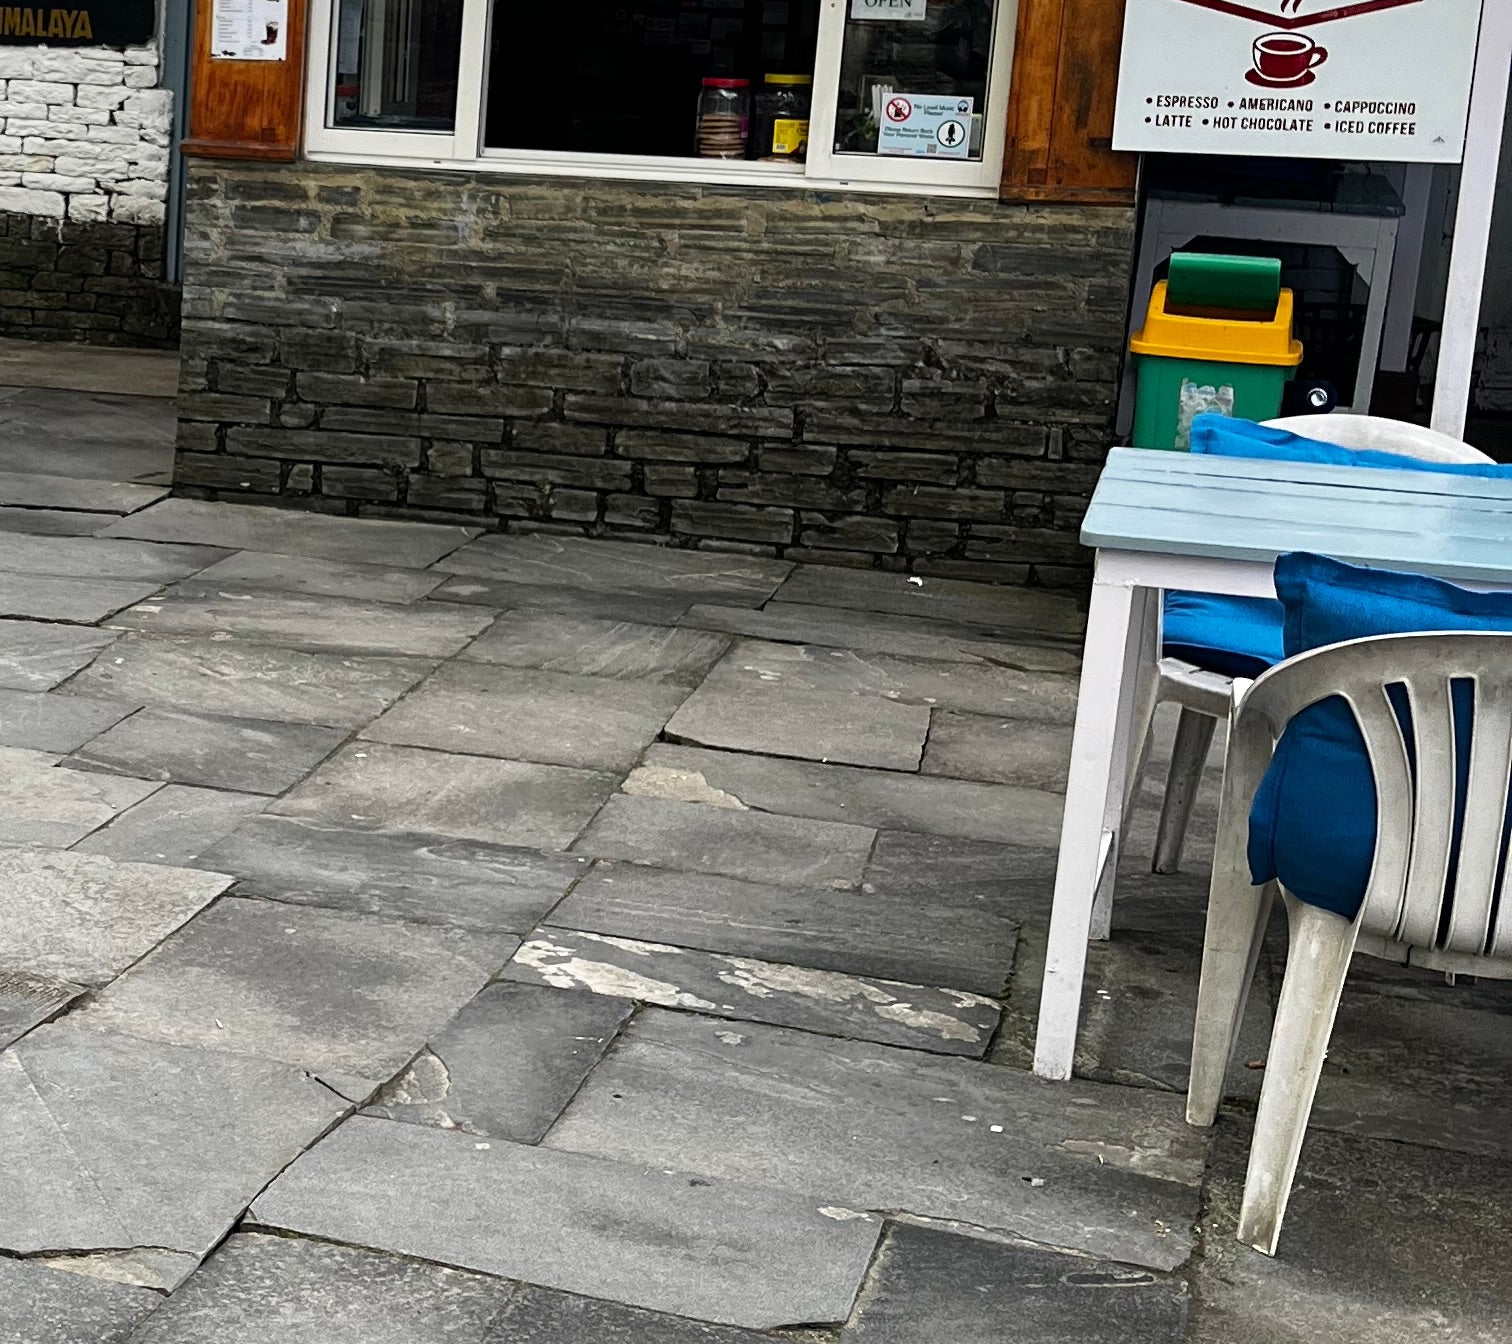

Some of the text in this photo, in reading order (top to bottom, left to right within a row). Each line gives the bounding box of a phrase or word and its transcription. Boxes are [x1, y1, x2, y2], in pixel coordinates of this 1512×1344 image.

[1156, 95, 1416, 115] ESPRESSO AMERICANO CAPPUCCINO
[1155, 114, 1416, 135] LATTE HOT CHOCOLATE ICED COFFEE
